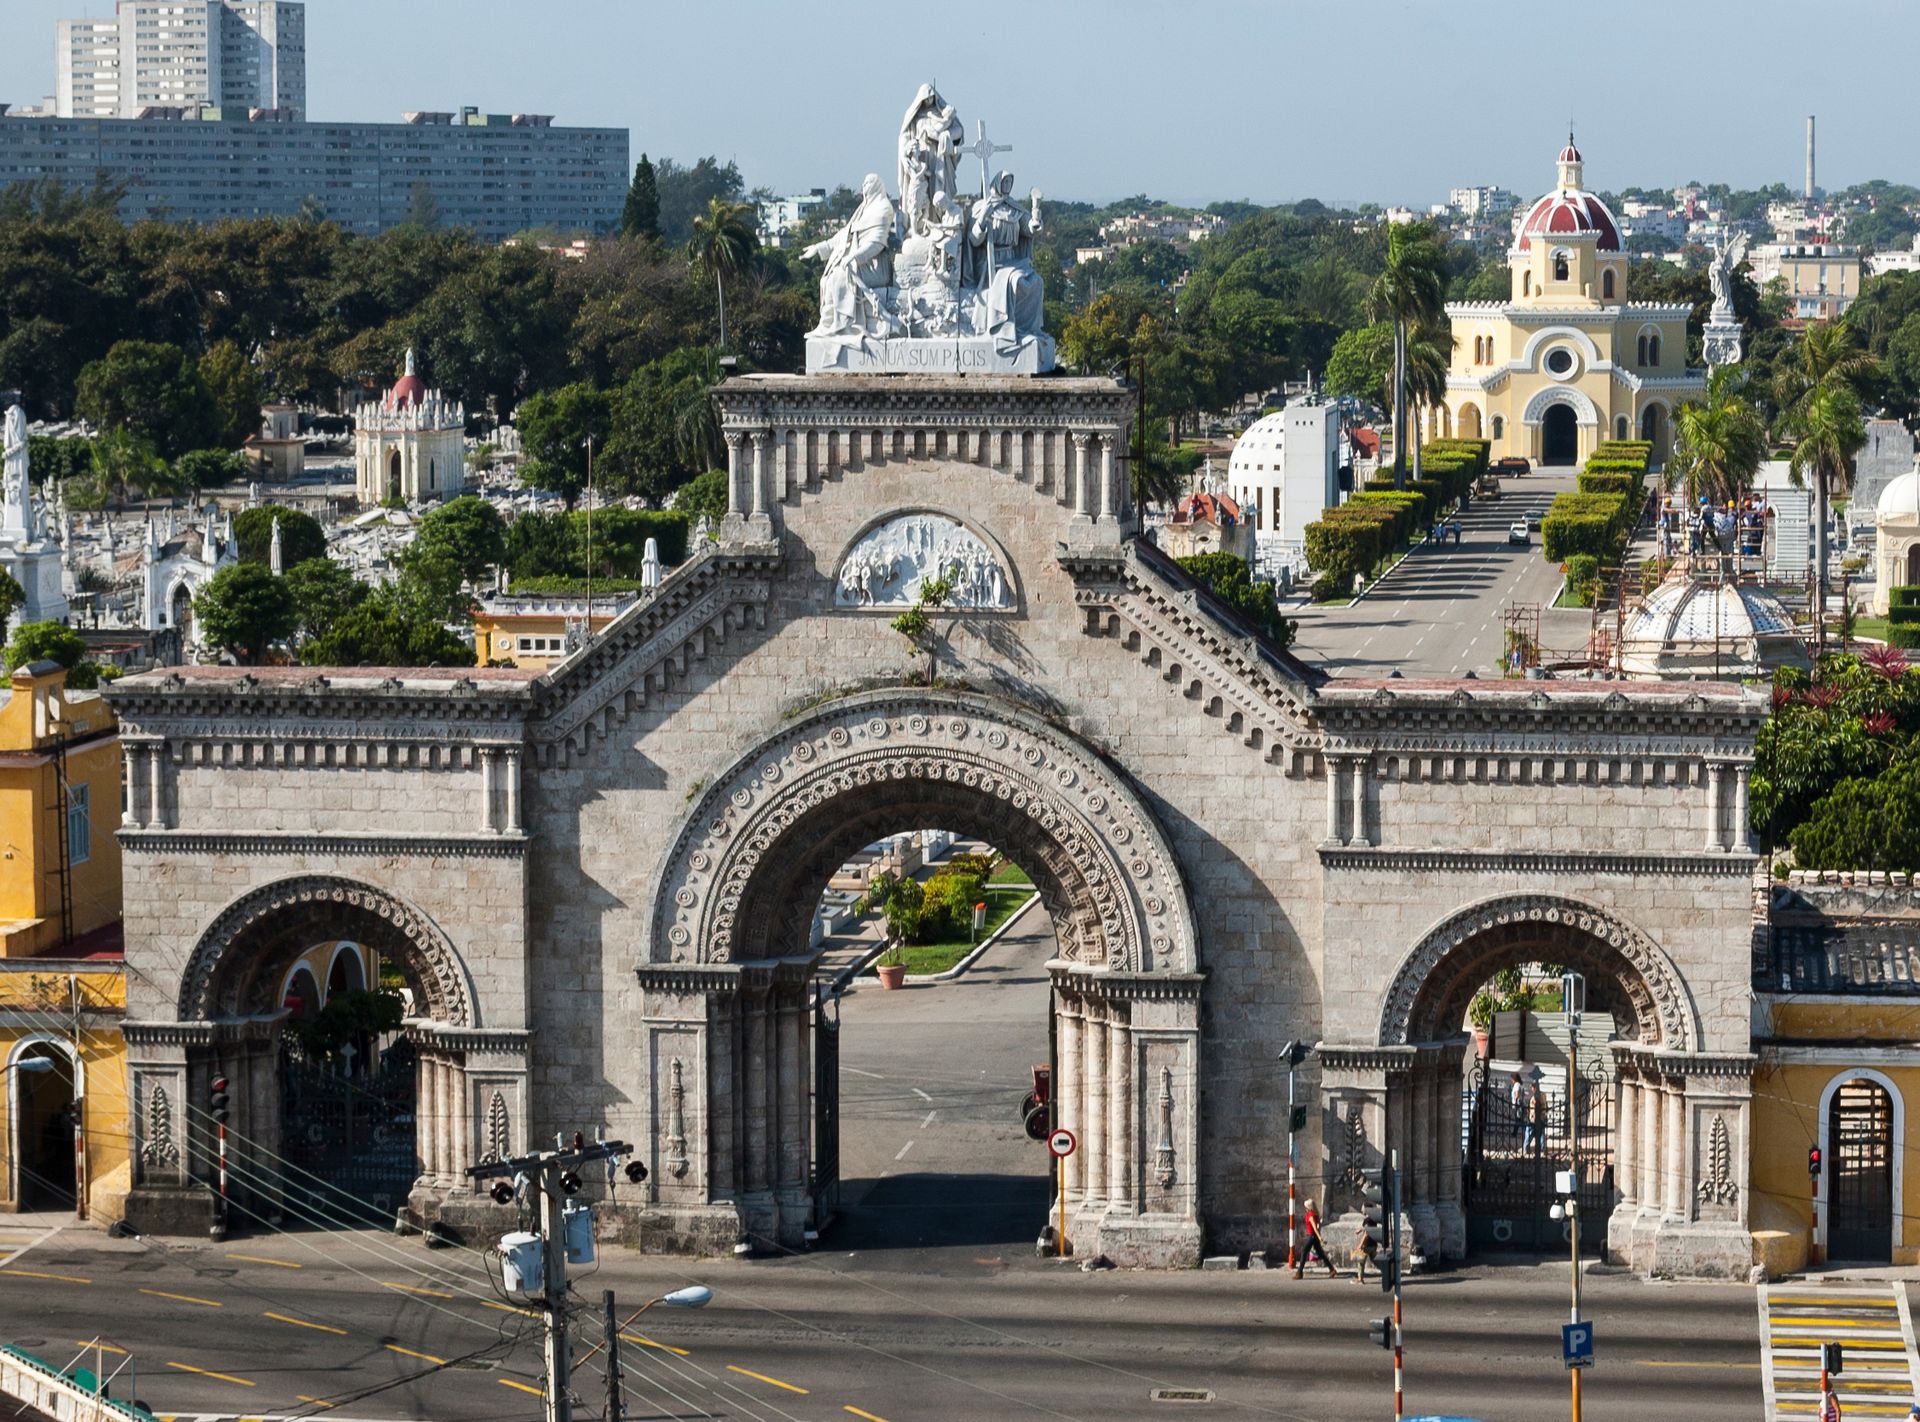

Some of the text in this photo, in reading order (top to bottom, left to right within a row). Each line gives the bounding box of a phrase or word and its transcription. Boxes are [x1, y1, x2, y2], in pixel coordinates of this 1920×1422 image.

[859, 348, 986, 367] JANUA SUM PACIS
[1570, 1330, 1587, 1353] P
